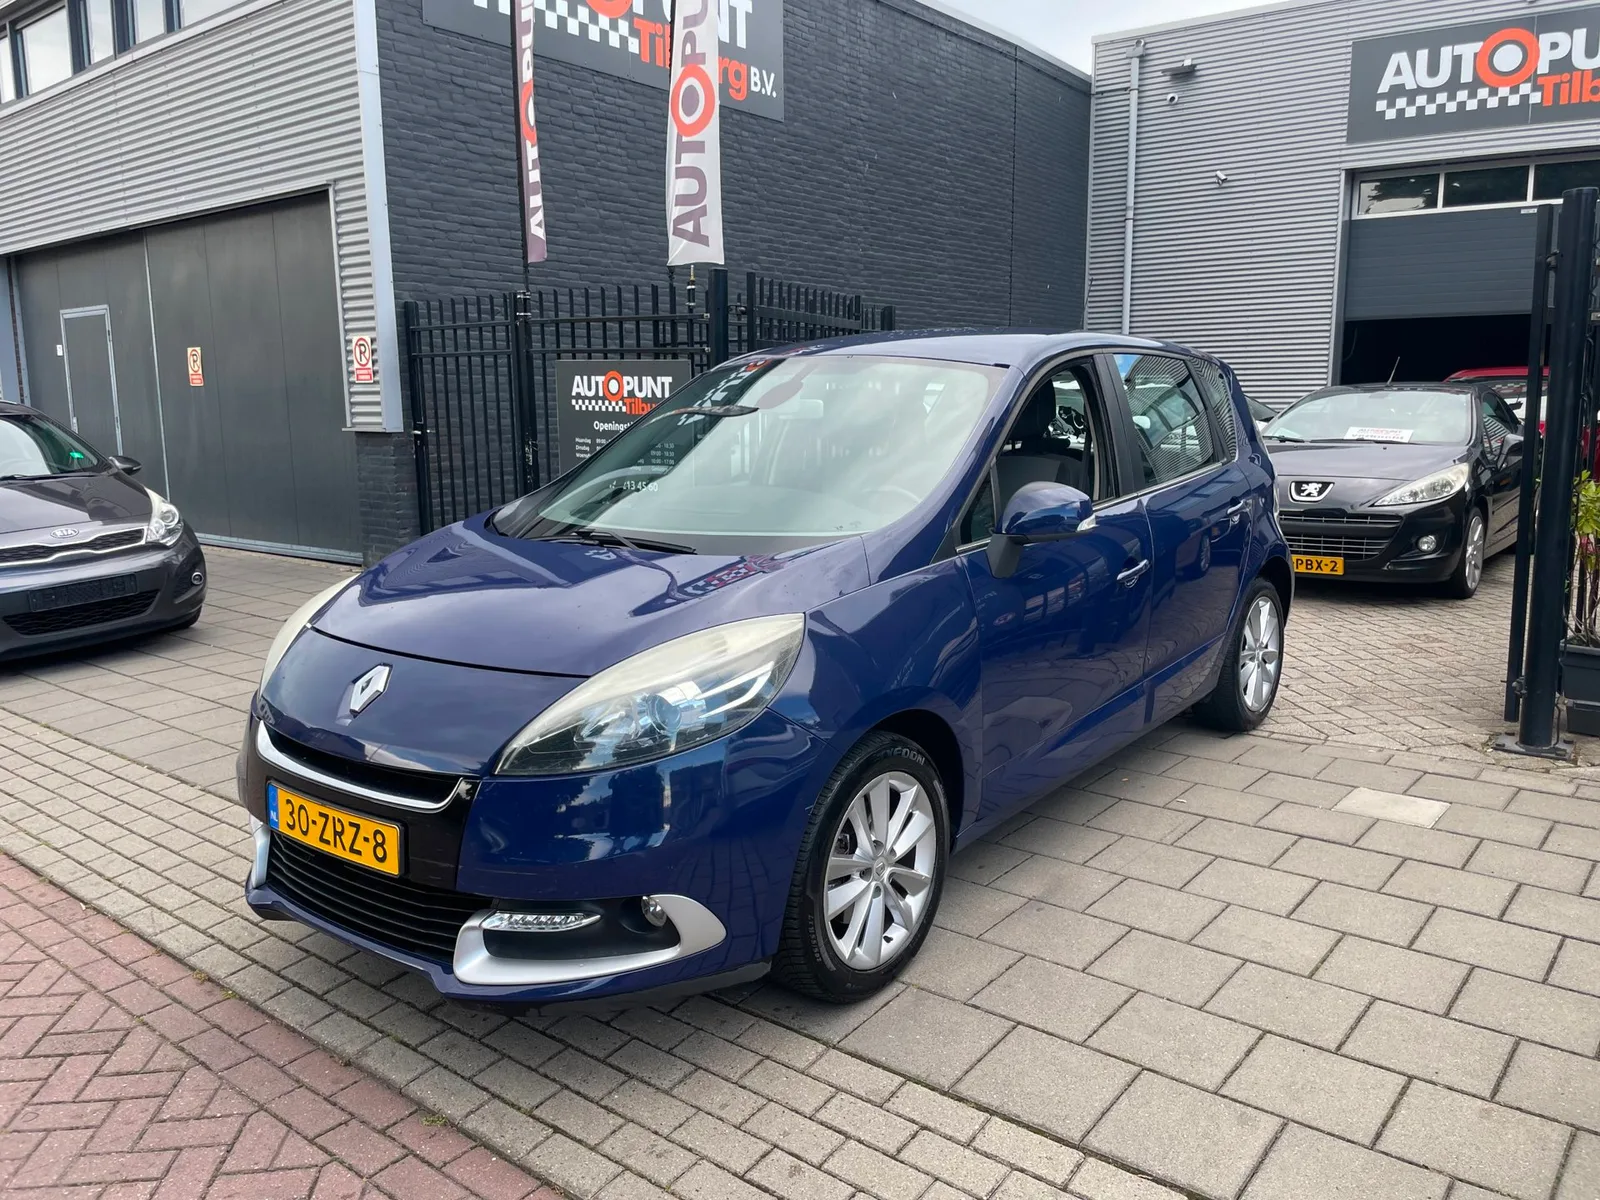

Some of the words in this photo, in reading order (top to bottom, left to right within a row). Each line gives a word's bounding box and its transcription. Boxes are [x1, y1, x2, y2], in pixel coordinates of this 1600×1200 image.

[633, 17, 748, 101] Tilrg
[751, 65, 776, 98] B.V.
[571, 370, 673, 402] AUTOPUNT
[270, 810, 279, 822] NL
[285, 798, 388, 864] 30-ZRZ-8
